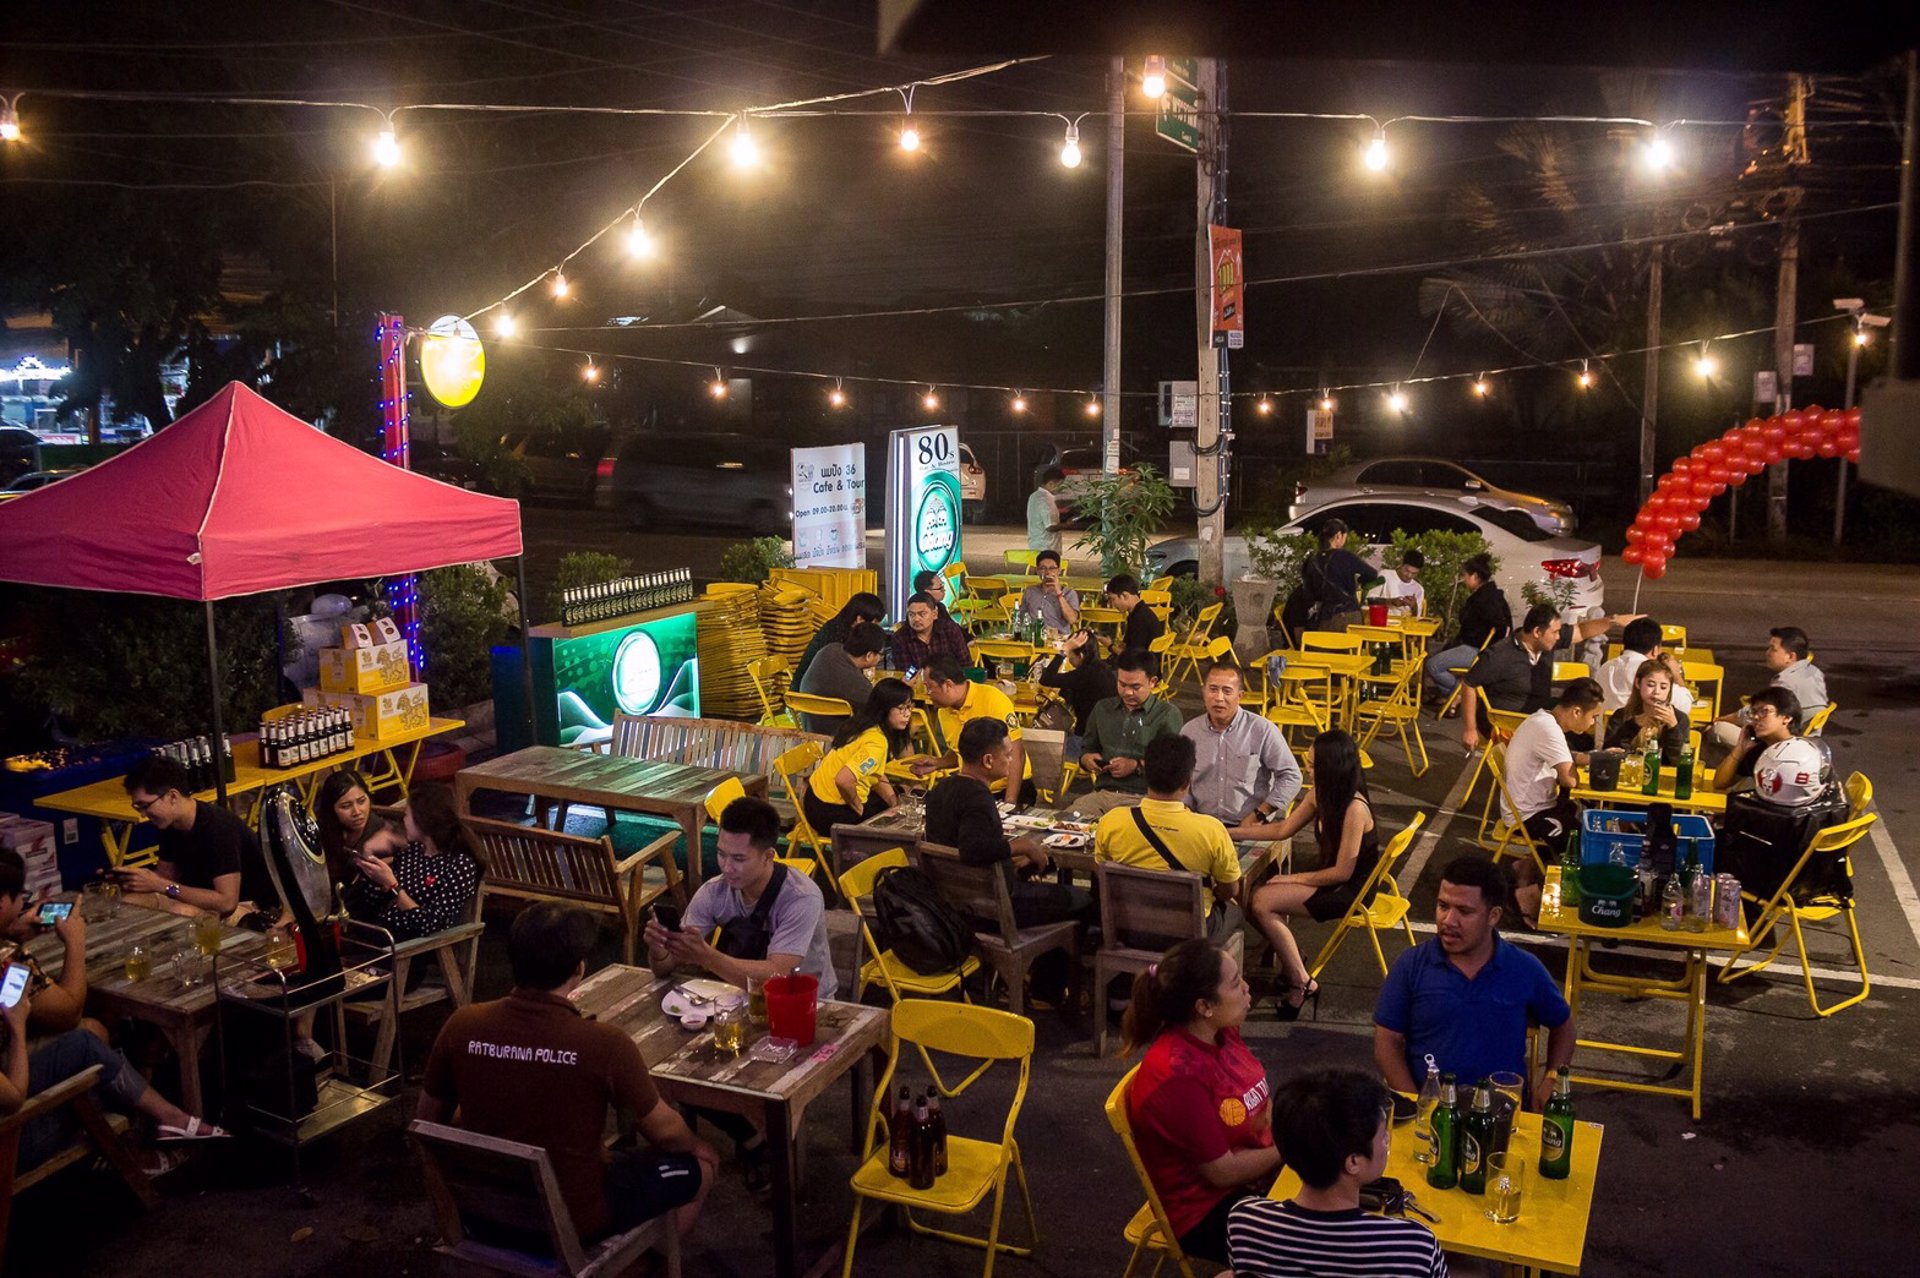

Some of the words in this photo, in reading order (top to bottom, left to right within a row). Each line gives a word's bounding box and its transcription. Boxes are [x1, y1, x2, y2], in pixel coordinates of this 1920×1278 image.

[845, 463, 857, 476] 36
[813, 481, 833, 494] Cafe
[836, 479, 843, 491] &
[847, 479, 865, 489] Tour
[796, 510, 811, 518] Open
[1591, 905, 1621, 918] Chang
[468, 1040, 533, 1061] RATBURANA
[534, 1049, 578, 1066] POLICE
